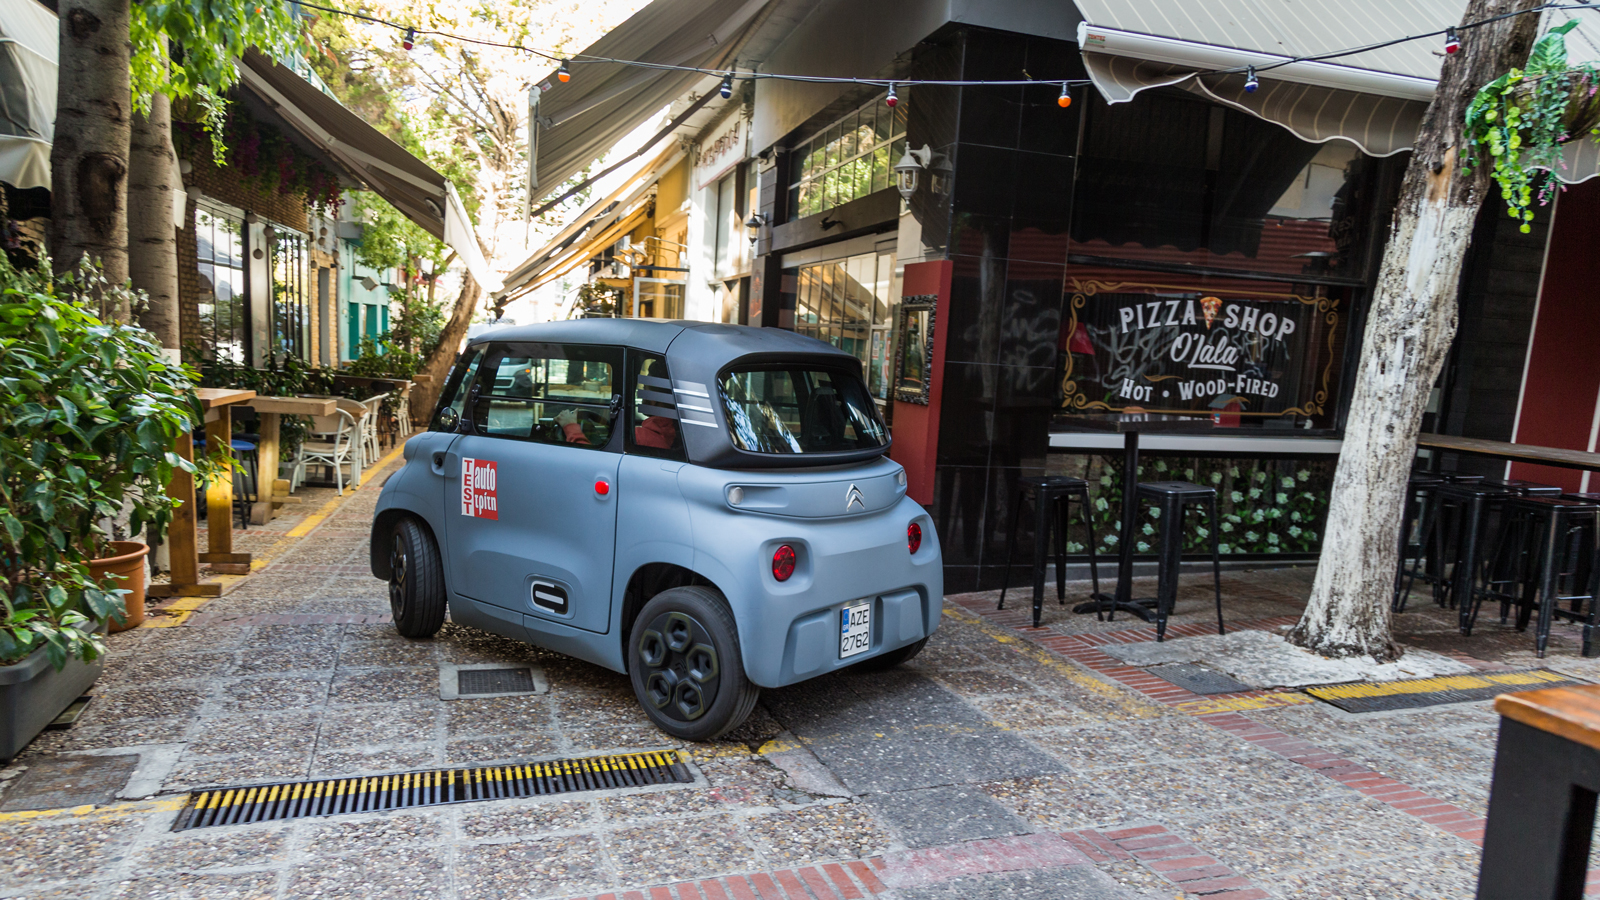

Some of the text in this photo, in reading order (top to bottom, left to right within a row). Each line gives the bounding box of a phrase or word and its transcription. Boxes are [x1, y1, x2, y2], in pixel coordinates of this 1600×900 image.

[1119, 300, 1296, 342] PIZZA SHOP
[463, 460, 473, 514] TEST
[474, 463, 496, 491] auto
[842, 631, 869, 652] 2762
